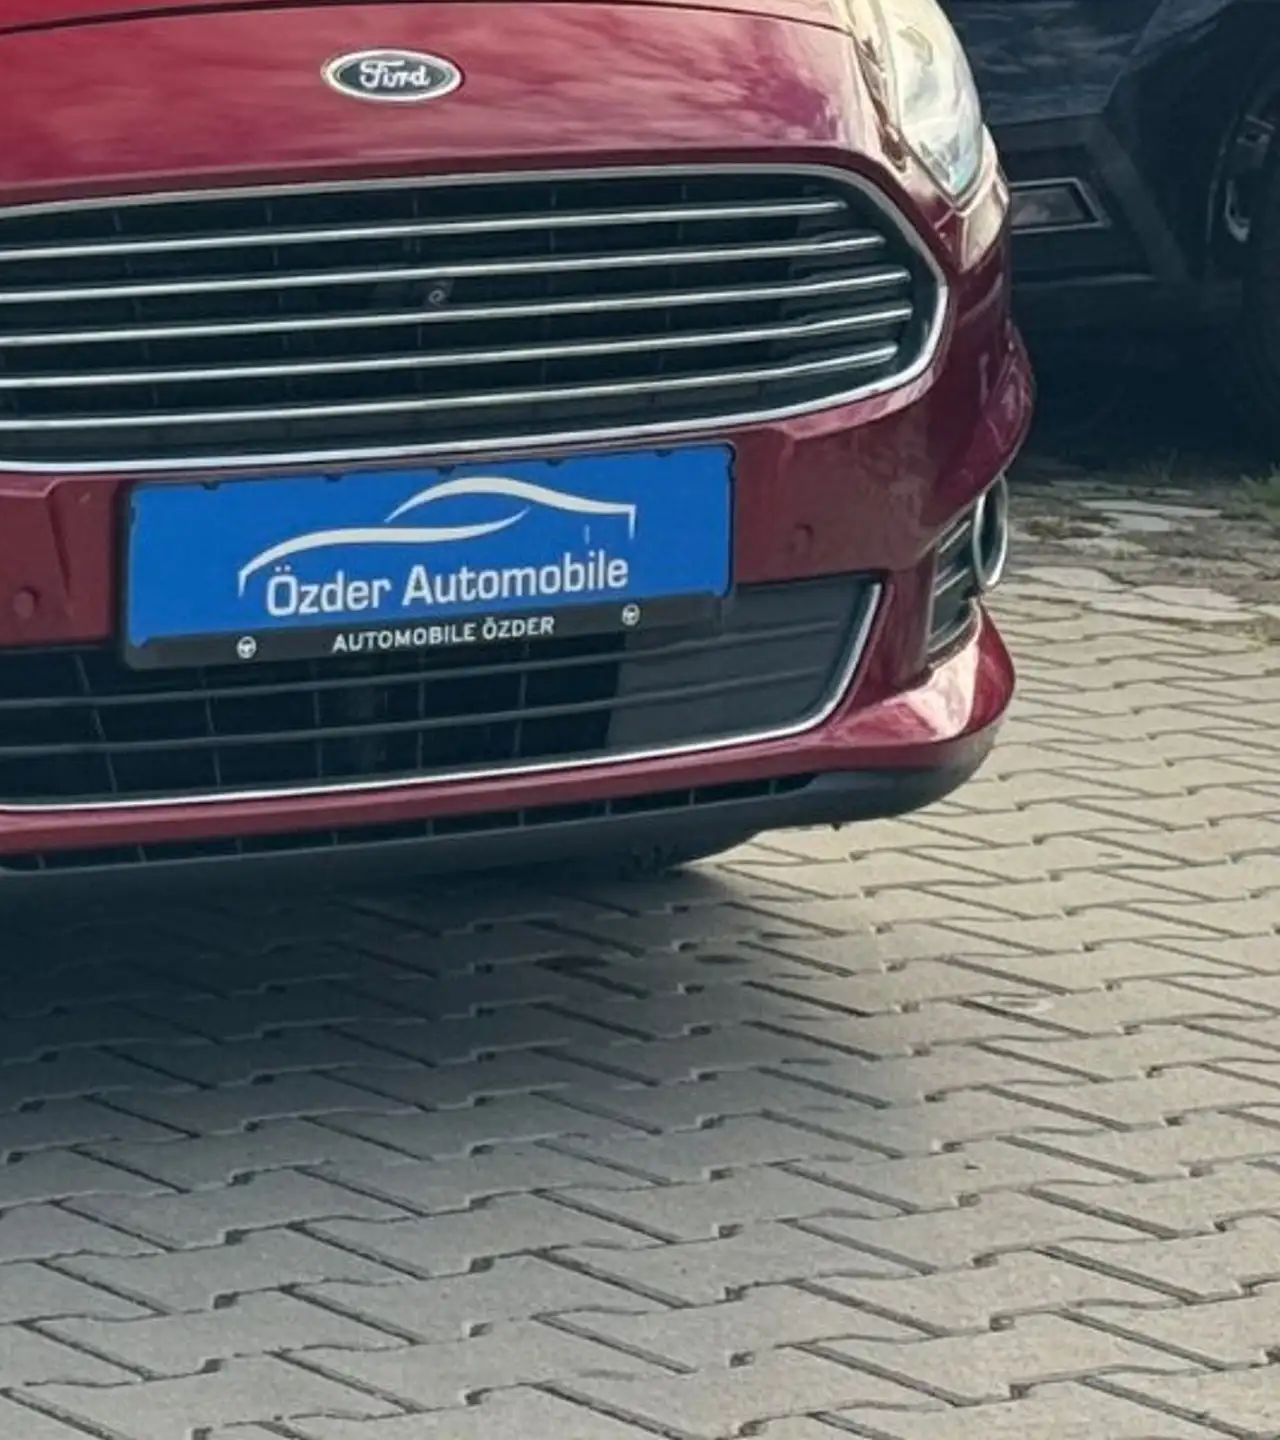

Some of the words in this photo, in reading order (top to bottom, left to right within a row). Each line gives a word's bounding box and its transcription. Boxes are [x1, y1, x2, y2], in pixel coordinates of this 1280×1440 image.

[358, 59, 432, 89] Ford
[266, 564, 392, 618] Özder
[402, 548, 629, 607] Automobile
[332, 621, 476, 655] AUTOMOBILE
[481, 616, 556, 640] ÖZDER
